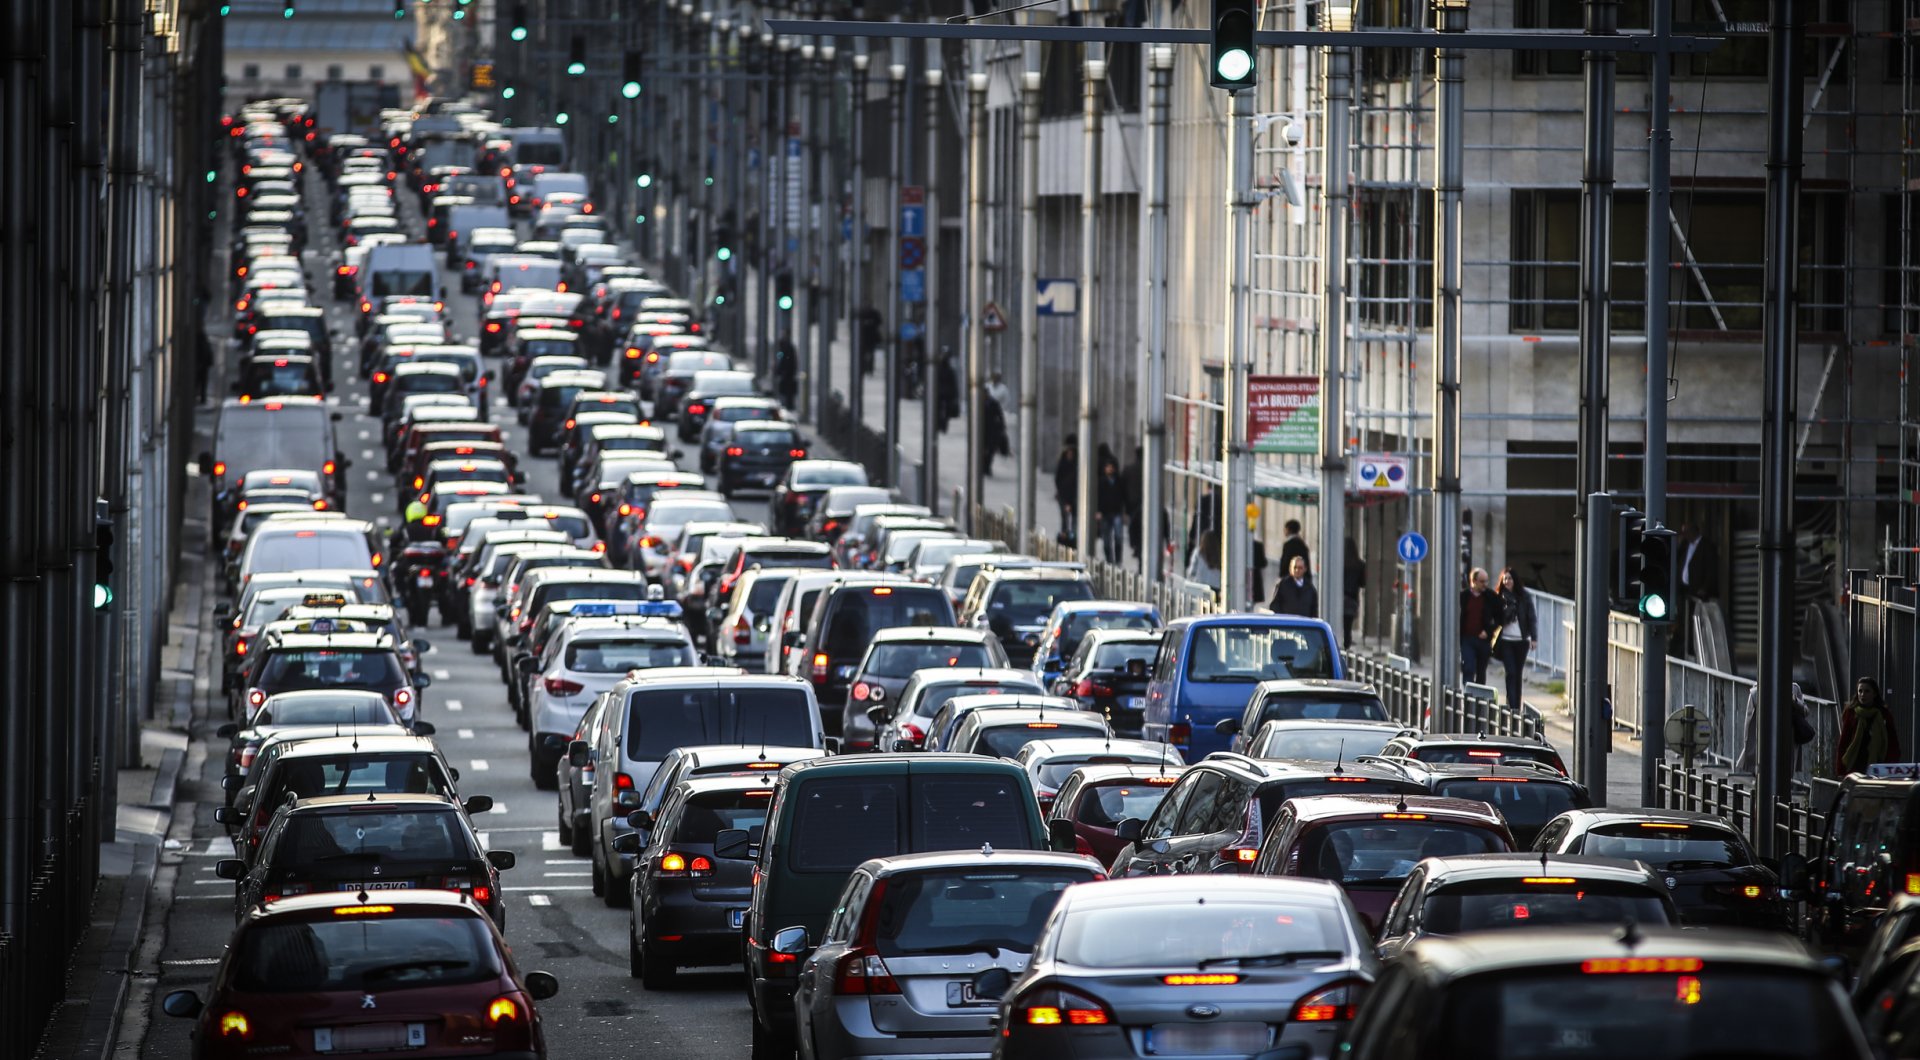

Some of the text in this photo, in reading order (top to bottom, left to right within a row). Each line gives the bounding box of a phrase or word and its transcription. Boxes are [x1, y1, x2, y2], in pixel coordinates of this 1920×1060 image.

[1725, 23, 1735, 32] LA
[1258, 394, 1269, 407] LA
[412, 1030, 421, 1040] B
